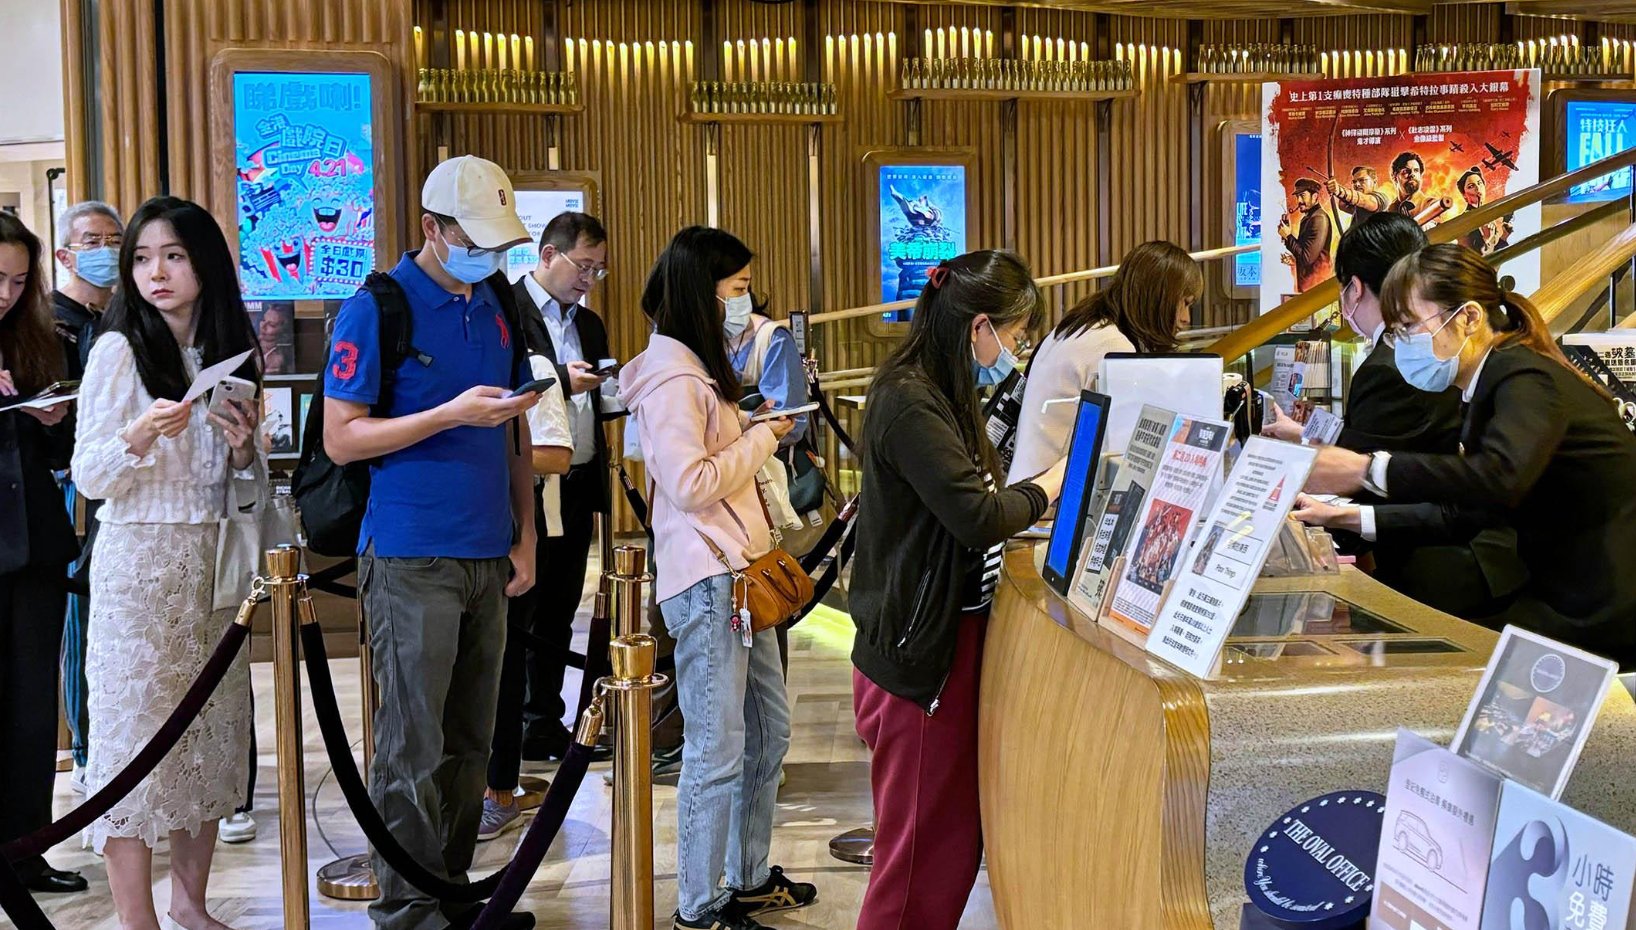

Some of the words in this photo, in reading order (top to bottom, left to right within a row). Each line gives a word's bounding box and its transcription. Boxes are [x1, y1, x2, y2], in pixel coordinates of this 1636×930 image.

[1580, 119, 1627, 133] 特技狂人
[267, 149, 321, 164] Cinema
[281, 163, 304, 175] Day
[309, 159, 347, 177] 4.21
[321, 255, 363, 278] $30
[333, 341, 358, 380] 3
[1283, 819, 1313, 845] THE
[1302, 835, 1335, 864] OVAL
[1325, 854, 1371, 892] OFFICE
[1572, 853, 1614, 901] 小時
